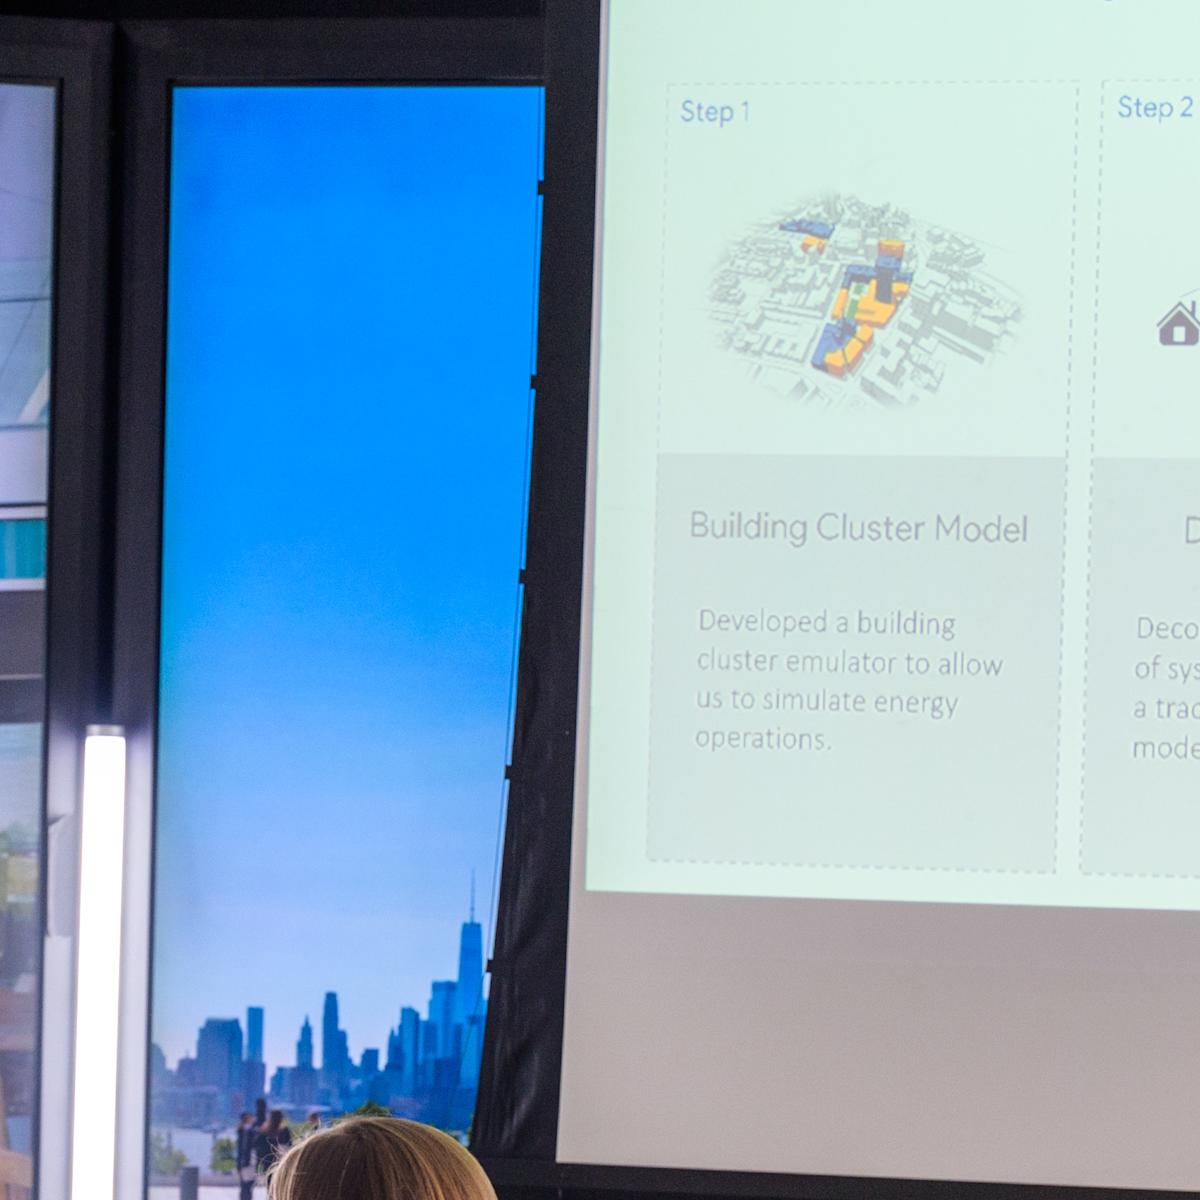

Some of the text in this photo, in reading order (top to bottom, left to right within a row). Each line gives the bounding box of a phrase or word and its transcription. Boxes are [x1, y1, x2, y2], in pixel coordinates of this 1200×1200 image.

[680, 99, 749, 128] Step 1
[1117, 94, 1194, 124] Step 2
[690, 510, 1029, 549] Building Cluster Model
[699, 608, 956, 642] Developed a building
[697, 648, 1003, 677] cluster emulator to allow
[1134, 655, 1163, 681] of
[695, 688, 959, 721] us to simulate energy
[1133, 701, 1147, 720] a
[695, 726, 832, 753] operations.
